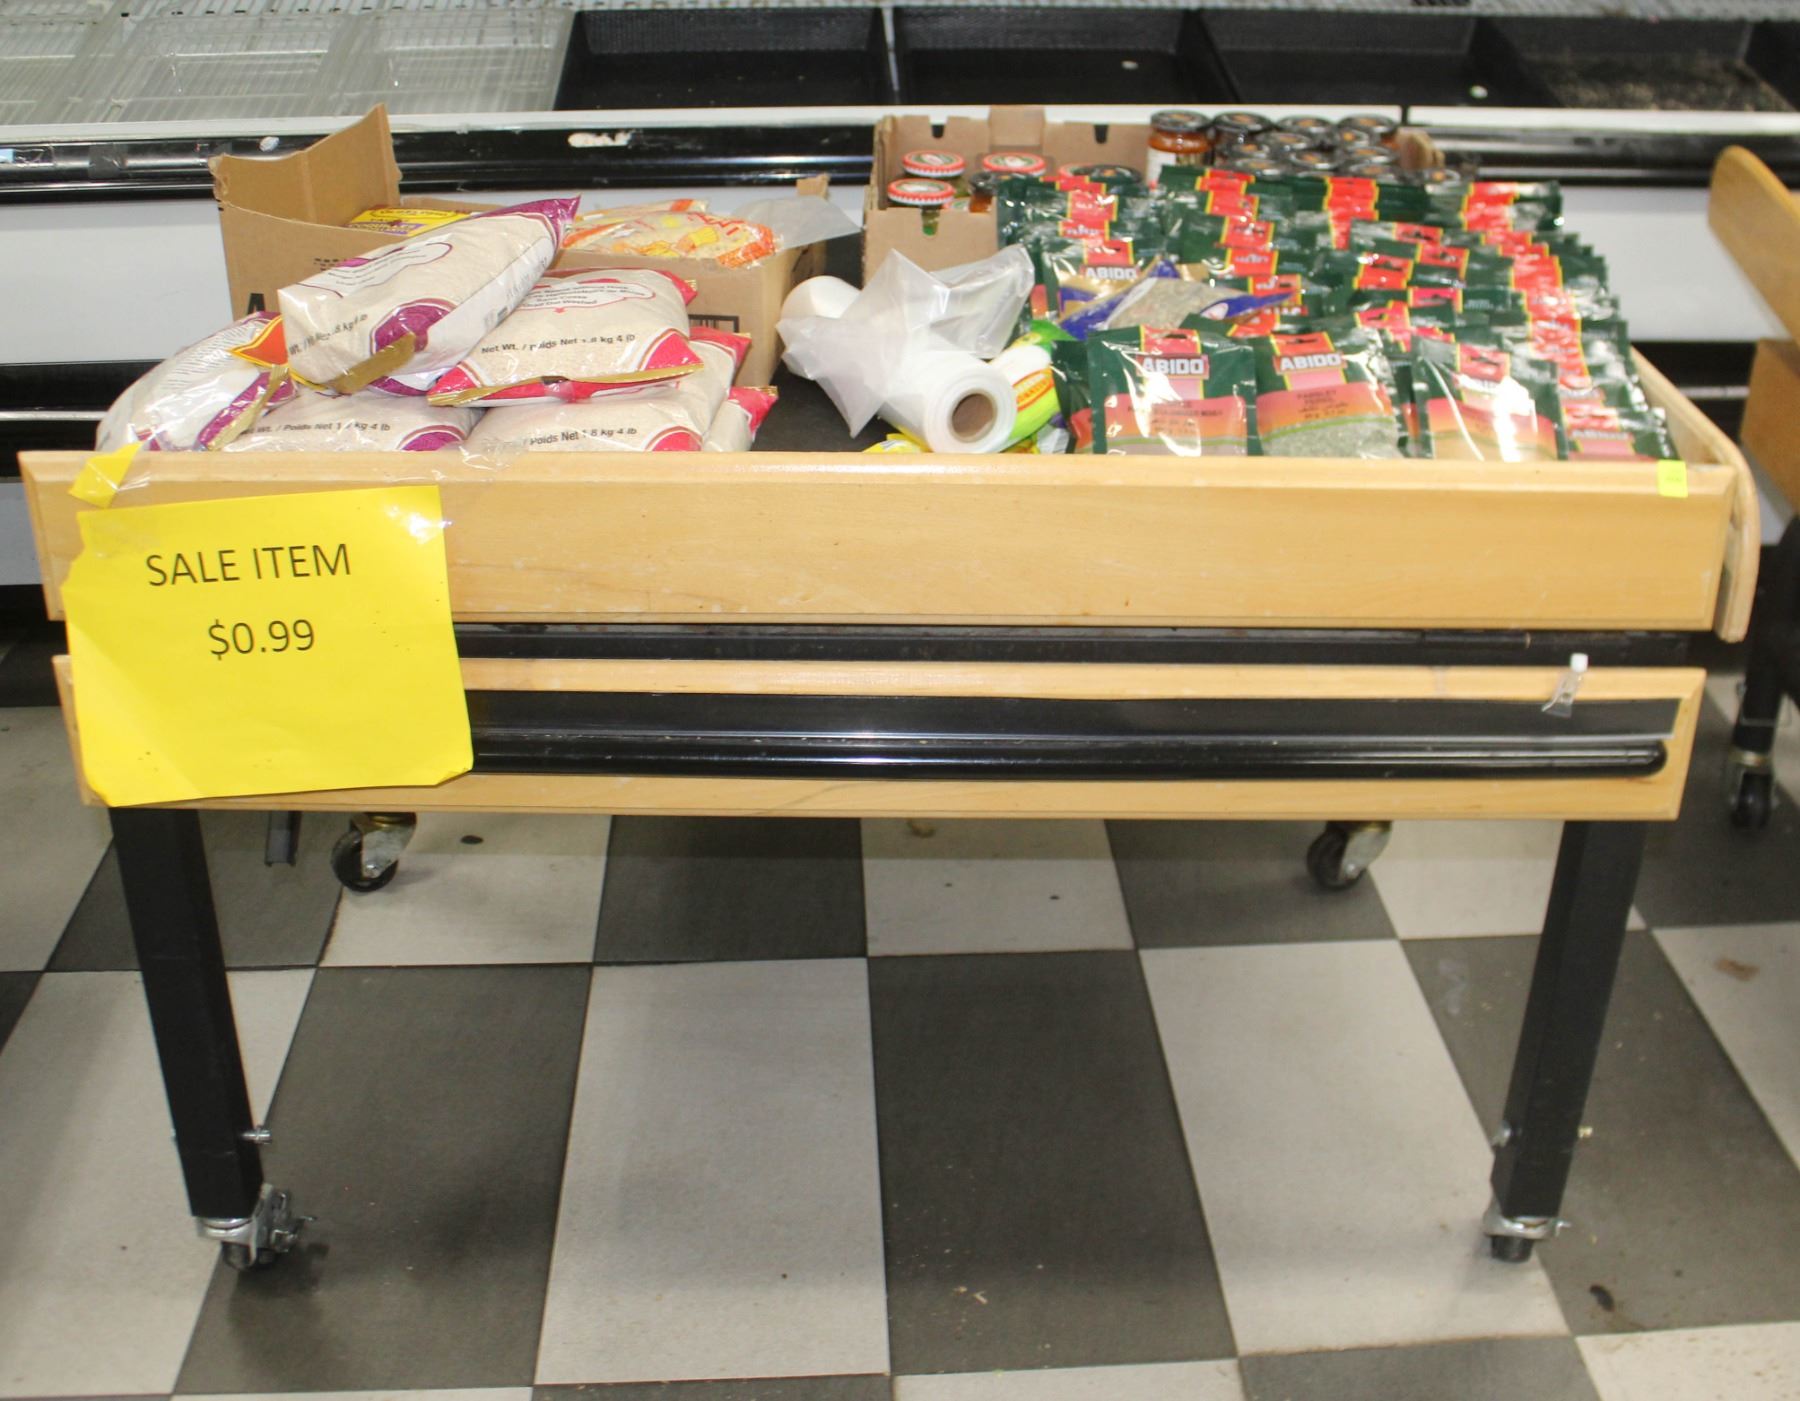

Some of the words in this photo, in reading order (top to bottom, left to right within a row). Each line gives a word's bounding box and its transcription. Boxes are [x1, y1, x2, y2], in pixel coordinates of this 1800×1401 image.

[481, 345, 500, 354] Net
[502, 343, 519, 351] Wt.
[560, 337, 578, 346] Net
[600, 336, 614, 345] kg
[616, 334, 623, 342] 4
[1142, 357, 1205, 375] ABIDO
[1280, 353, 1341, 372] ABIDO
[283, 423, 311, 432] Poids
[314, 422, 333, 430] Net
[353, 422, 368, 431] kg
[370, 422, 378, 430] 4
[380, 422, 391, 431] lb
[561, 430, 580, 441] Net
[600, 428, 614, 437] kg
[616, 427, 624, 435] 4
[626, 427, 638, 436] lb
[146, 549, 241, 587] SALE
[252, 543, 351, 580] ITEM
[207, 618, 315, 661] $0.99
